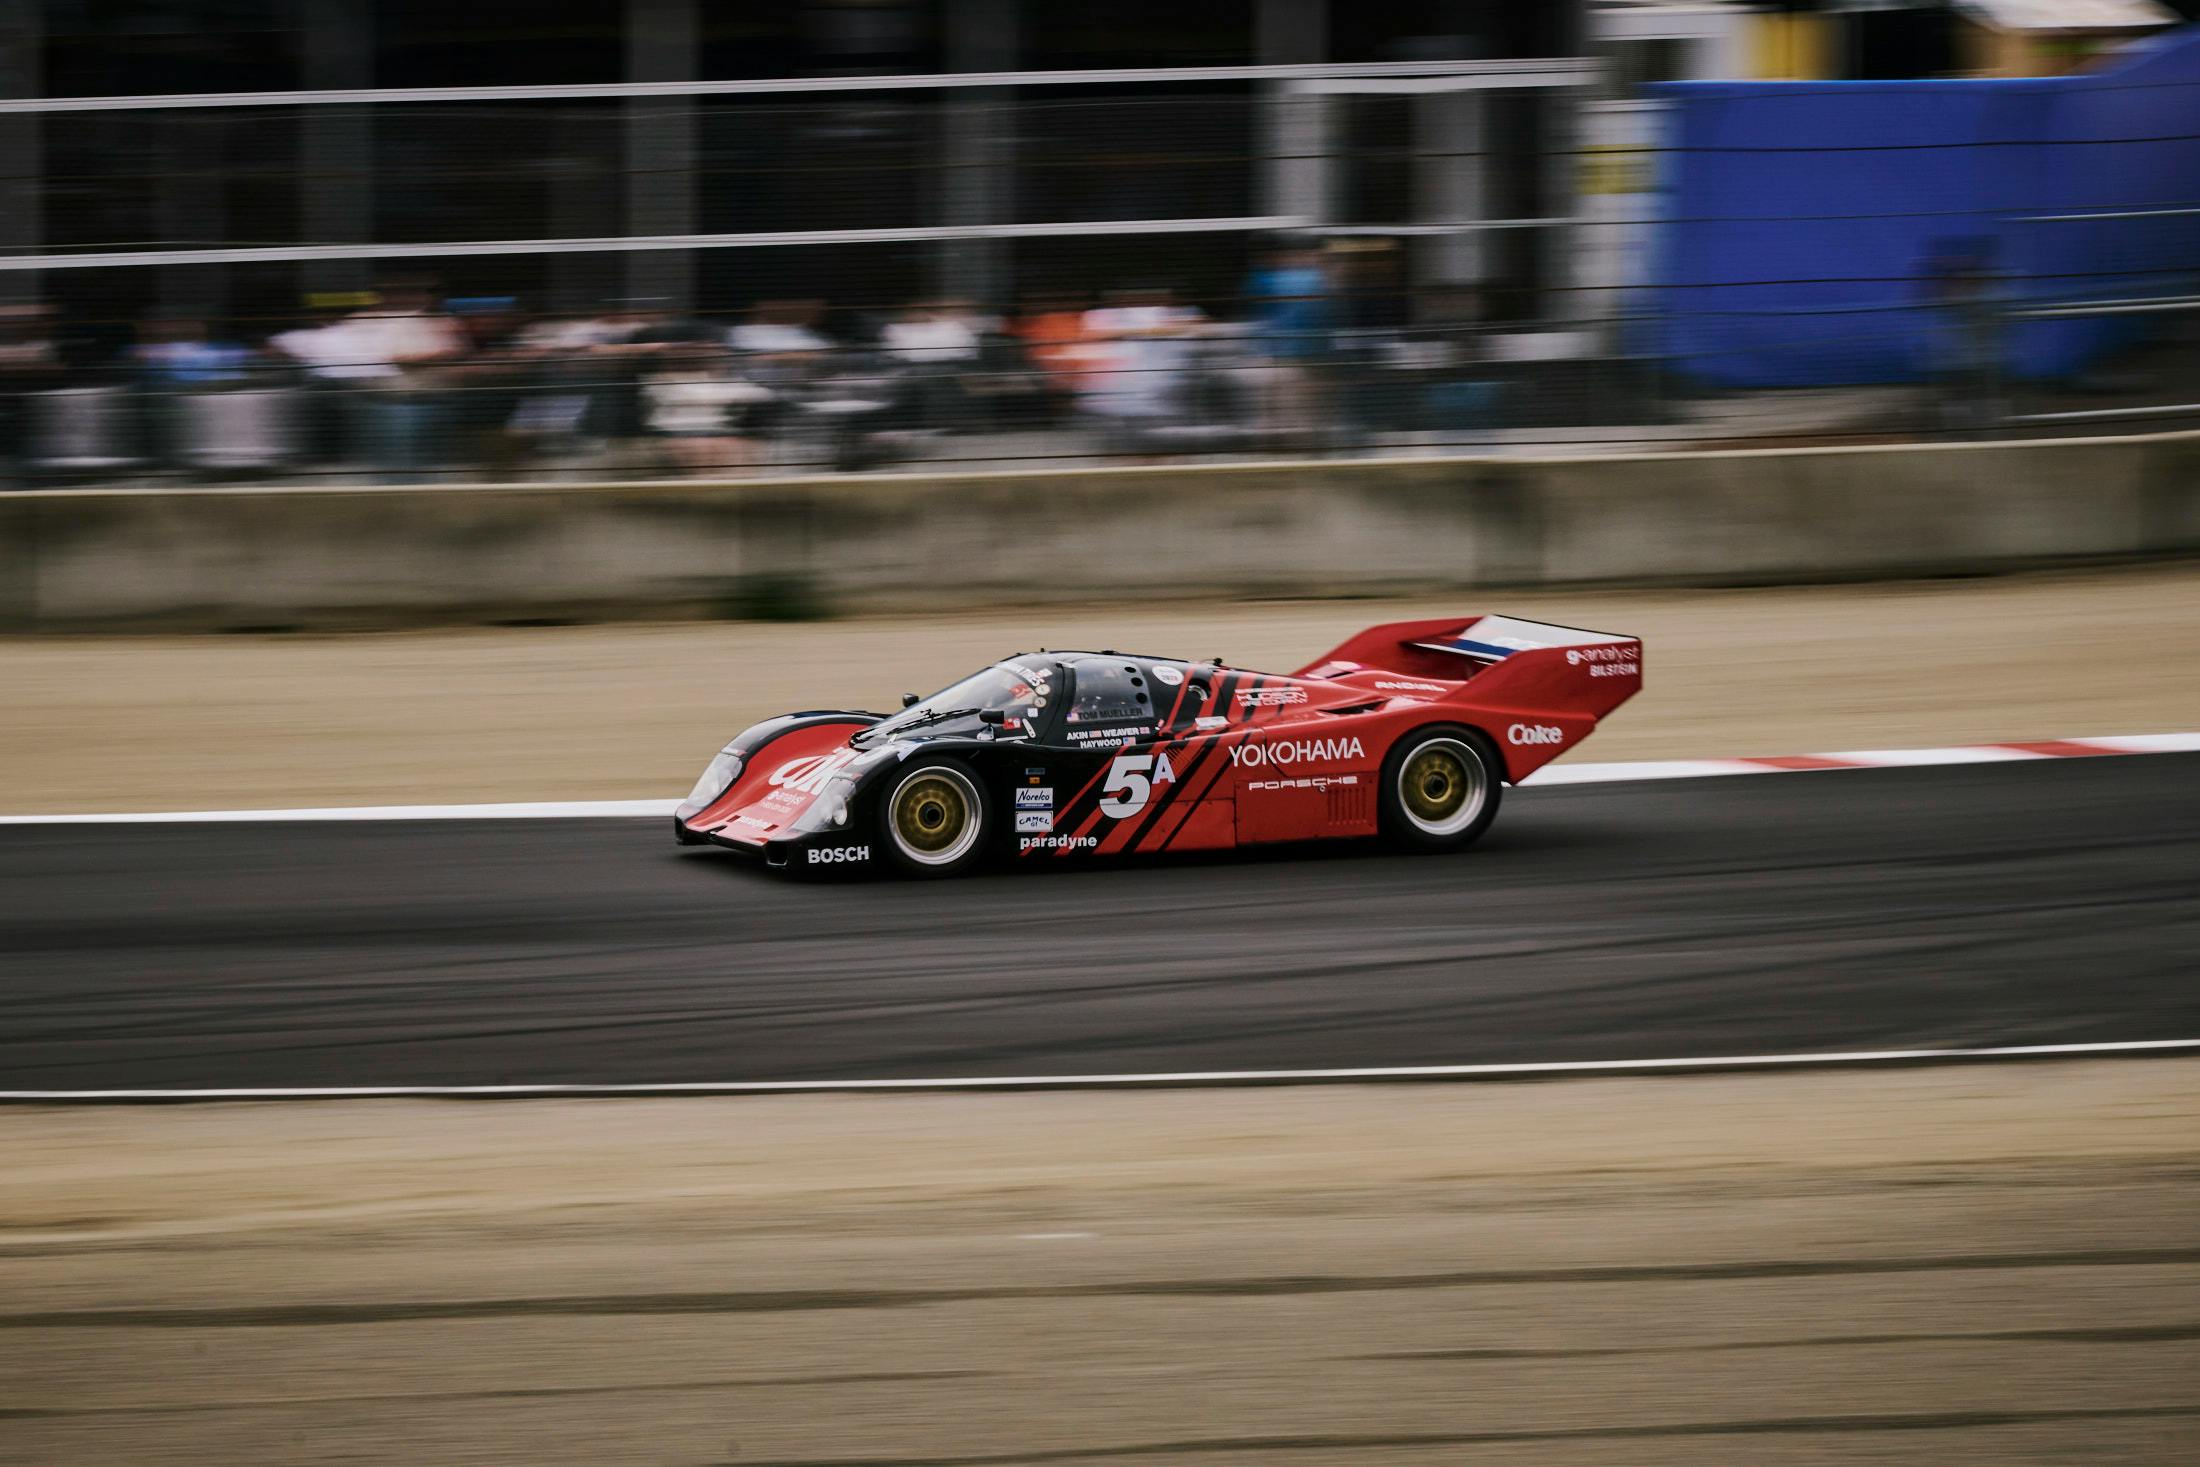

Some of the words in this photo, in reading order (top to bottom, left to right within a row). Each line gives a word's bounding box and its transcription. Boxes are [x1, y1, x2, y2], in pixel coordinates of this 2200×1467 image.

[1078, 711, 1098, 720] TOM
[1099, 708, 1143, 719] MUELLER
[1067, 732, 1088, 741] AKIN
[1102, 727, 1139, 738] WEAVER
[1507, 723, 1564, 746] Coke
[1080, 738, 1122, 749] HAYWOOD
[1228, 736, 1365, 767] YOKOHAMA
[1248, 776, 1358, 791] PORSCHE
[1017, 788, 1050, 803] Norelco
[1019, 816, 1050, 825] CAMEL
[1020, 834, 1098, 850] paradyne
[808, 845, 870, 864] BOSCH
